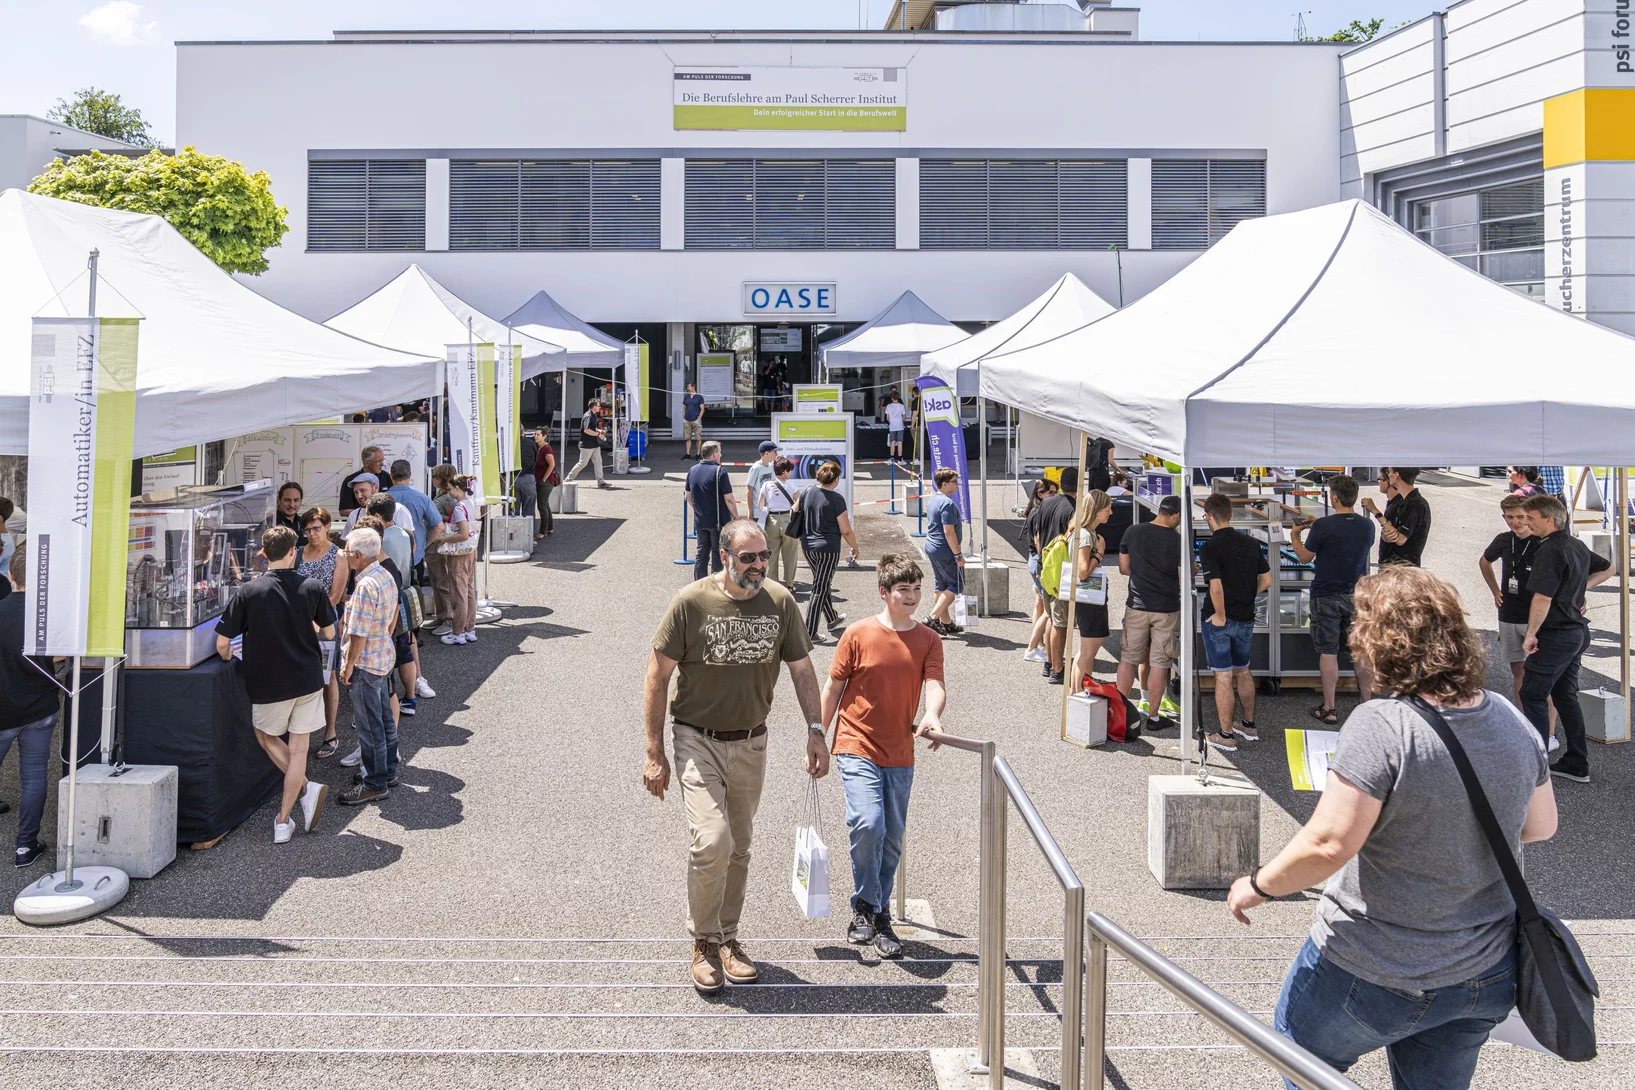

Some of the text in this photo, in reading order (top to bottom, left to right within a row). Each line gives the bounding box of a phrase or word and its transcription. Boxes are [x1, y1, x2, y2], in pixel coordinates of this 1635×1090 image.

[1611, 44, 1634, 73] psi
[682, 92, 700, 102] Die
[703, 93, 763, 103] Berufslehre
[785, 94, 808, 104] Paul
[810, 94, 856, 104] Scherrer
[858, 94, 898, 104] Institut
[772, 109, 817, 118] erfolgreicher
[752, 288, 830, 308] OASE
[72, 334, 96, 528] Automatiker/in EFZ
[468, 372, 480, 466] Kauffrau/Kaufmann
[40, 544, 48, 589] FORSCHUNG
[38, 630, 45, 641] AM
[707, 620, 780, 644] SAN FRANCISCO
